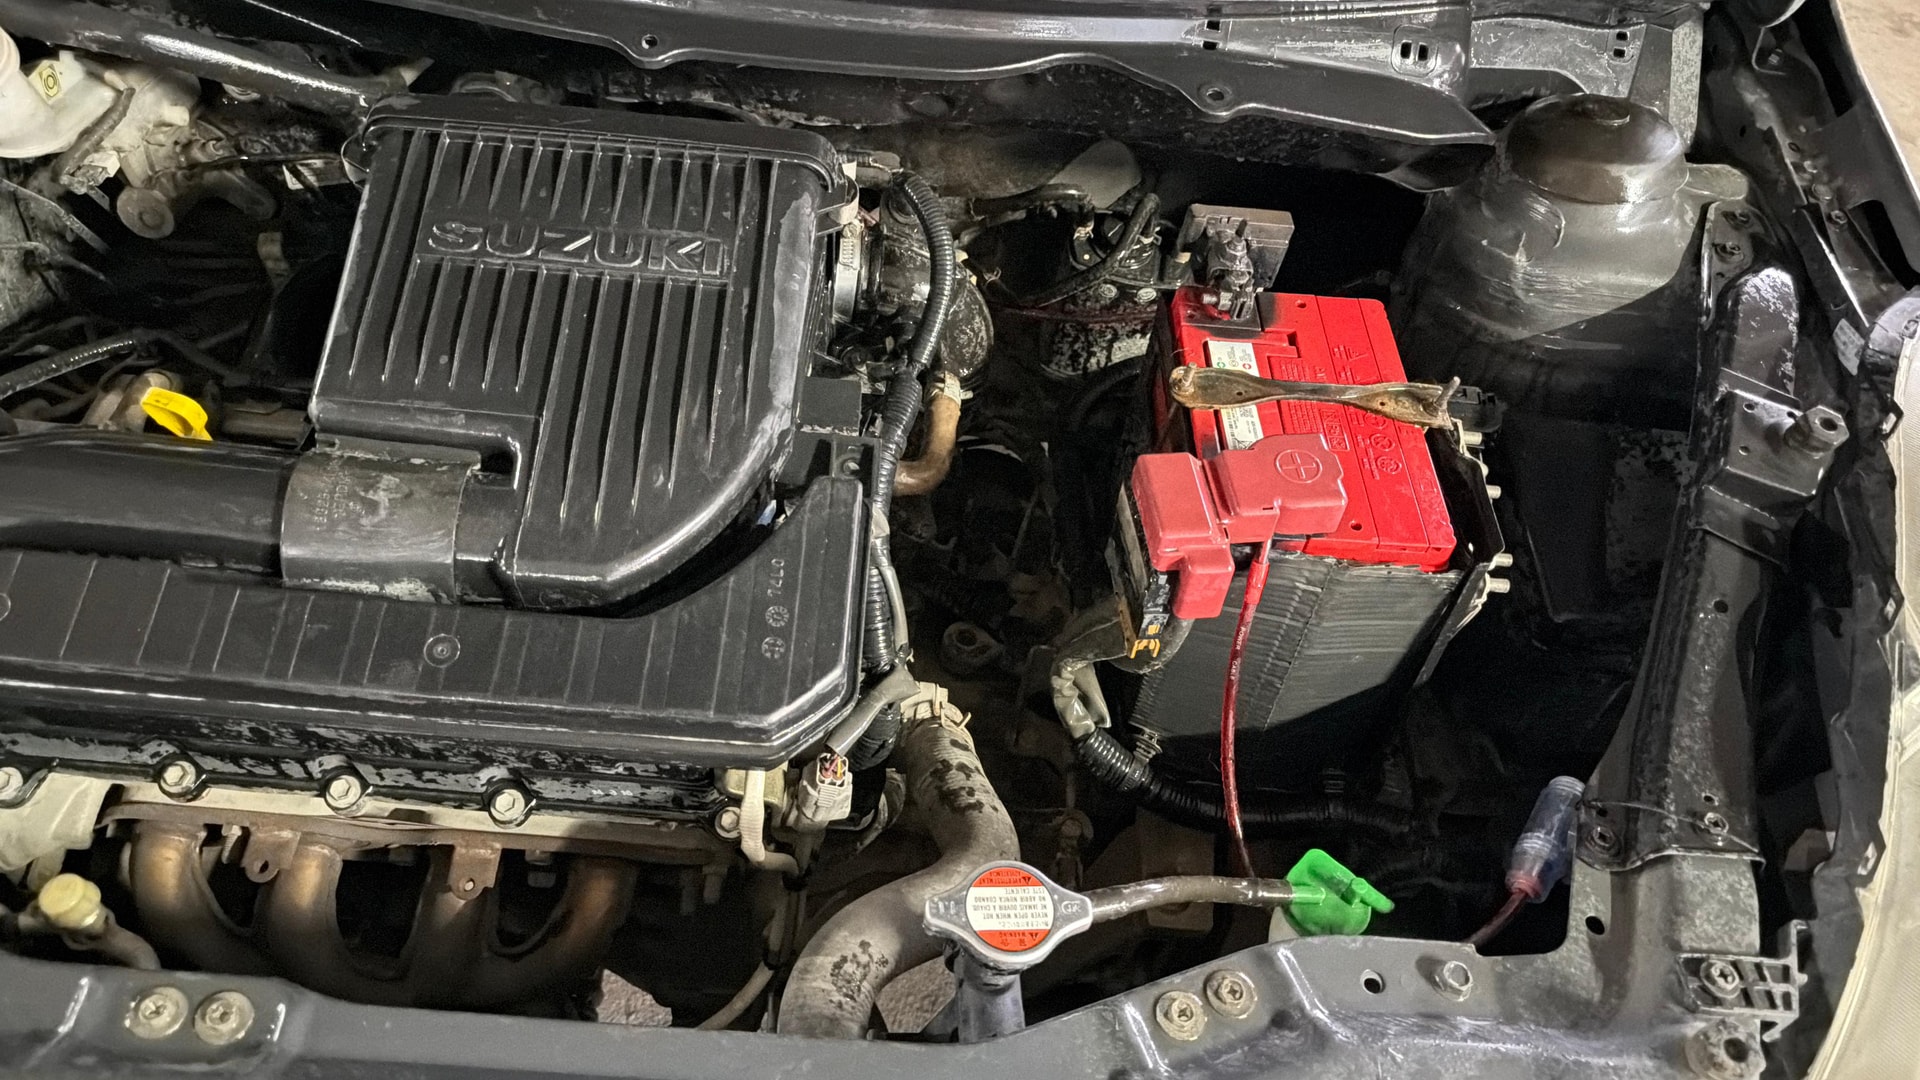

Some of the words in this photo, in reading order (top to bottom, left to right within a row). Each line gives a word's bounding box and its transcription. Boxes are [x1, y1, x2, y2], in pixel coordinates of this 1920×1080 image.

[428, 221, 726, 275] SUZUKI
[1235, 626, 1246, 650] POWER
[1230, 660, 1238, 680] CABLE
